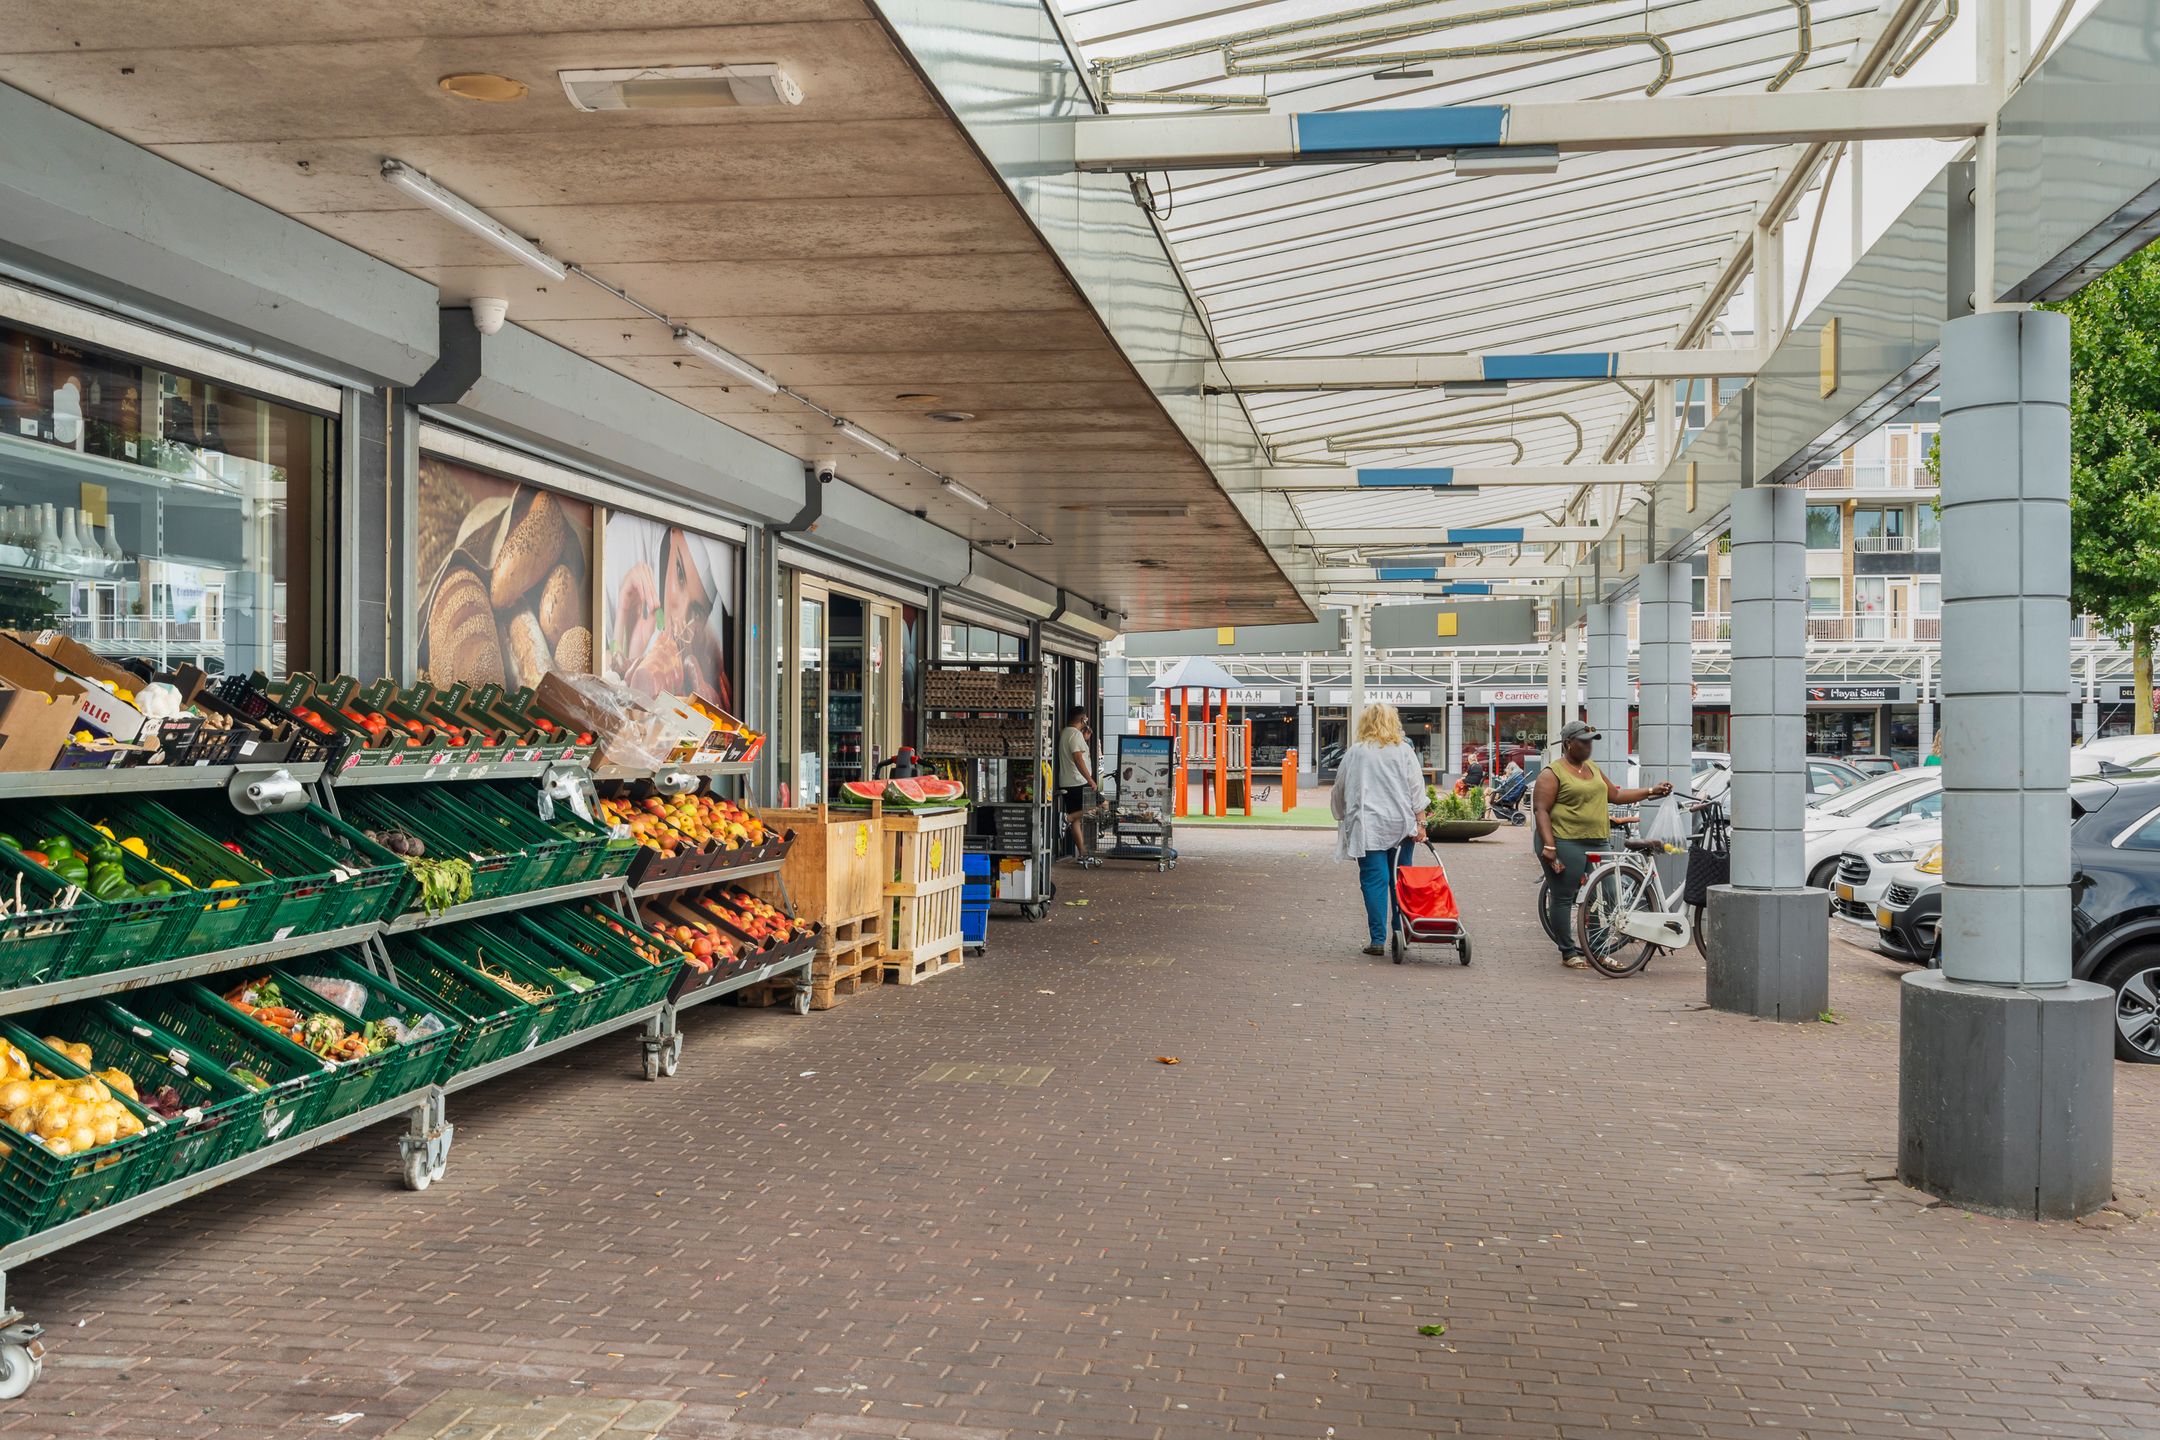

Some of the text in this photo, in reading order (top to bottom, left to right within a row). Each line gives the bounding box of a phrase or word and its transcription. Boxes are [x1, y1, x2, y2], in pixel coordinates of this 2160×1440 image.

[1209, 690, 1262, 698] AINAH
[1364, 691, 1413, 700] MINAH
[1504, 691, 1540, 700] carrière
[1830, 688, 1886, 699] Hayai Sushi
[81, 700, 111, 724] RLIC
[1528, 732, 1548, 740] carr
